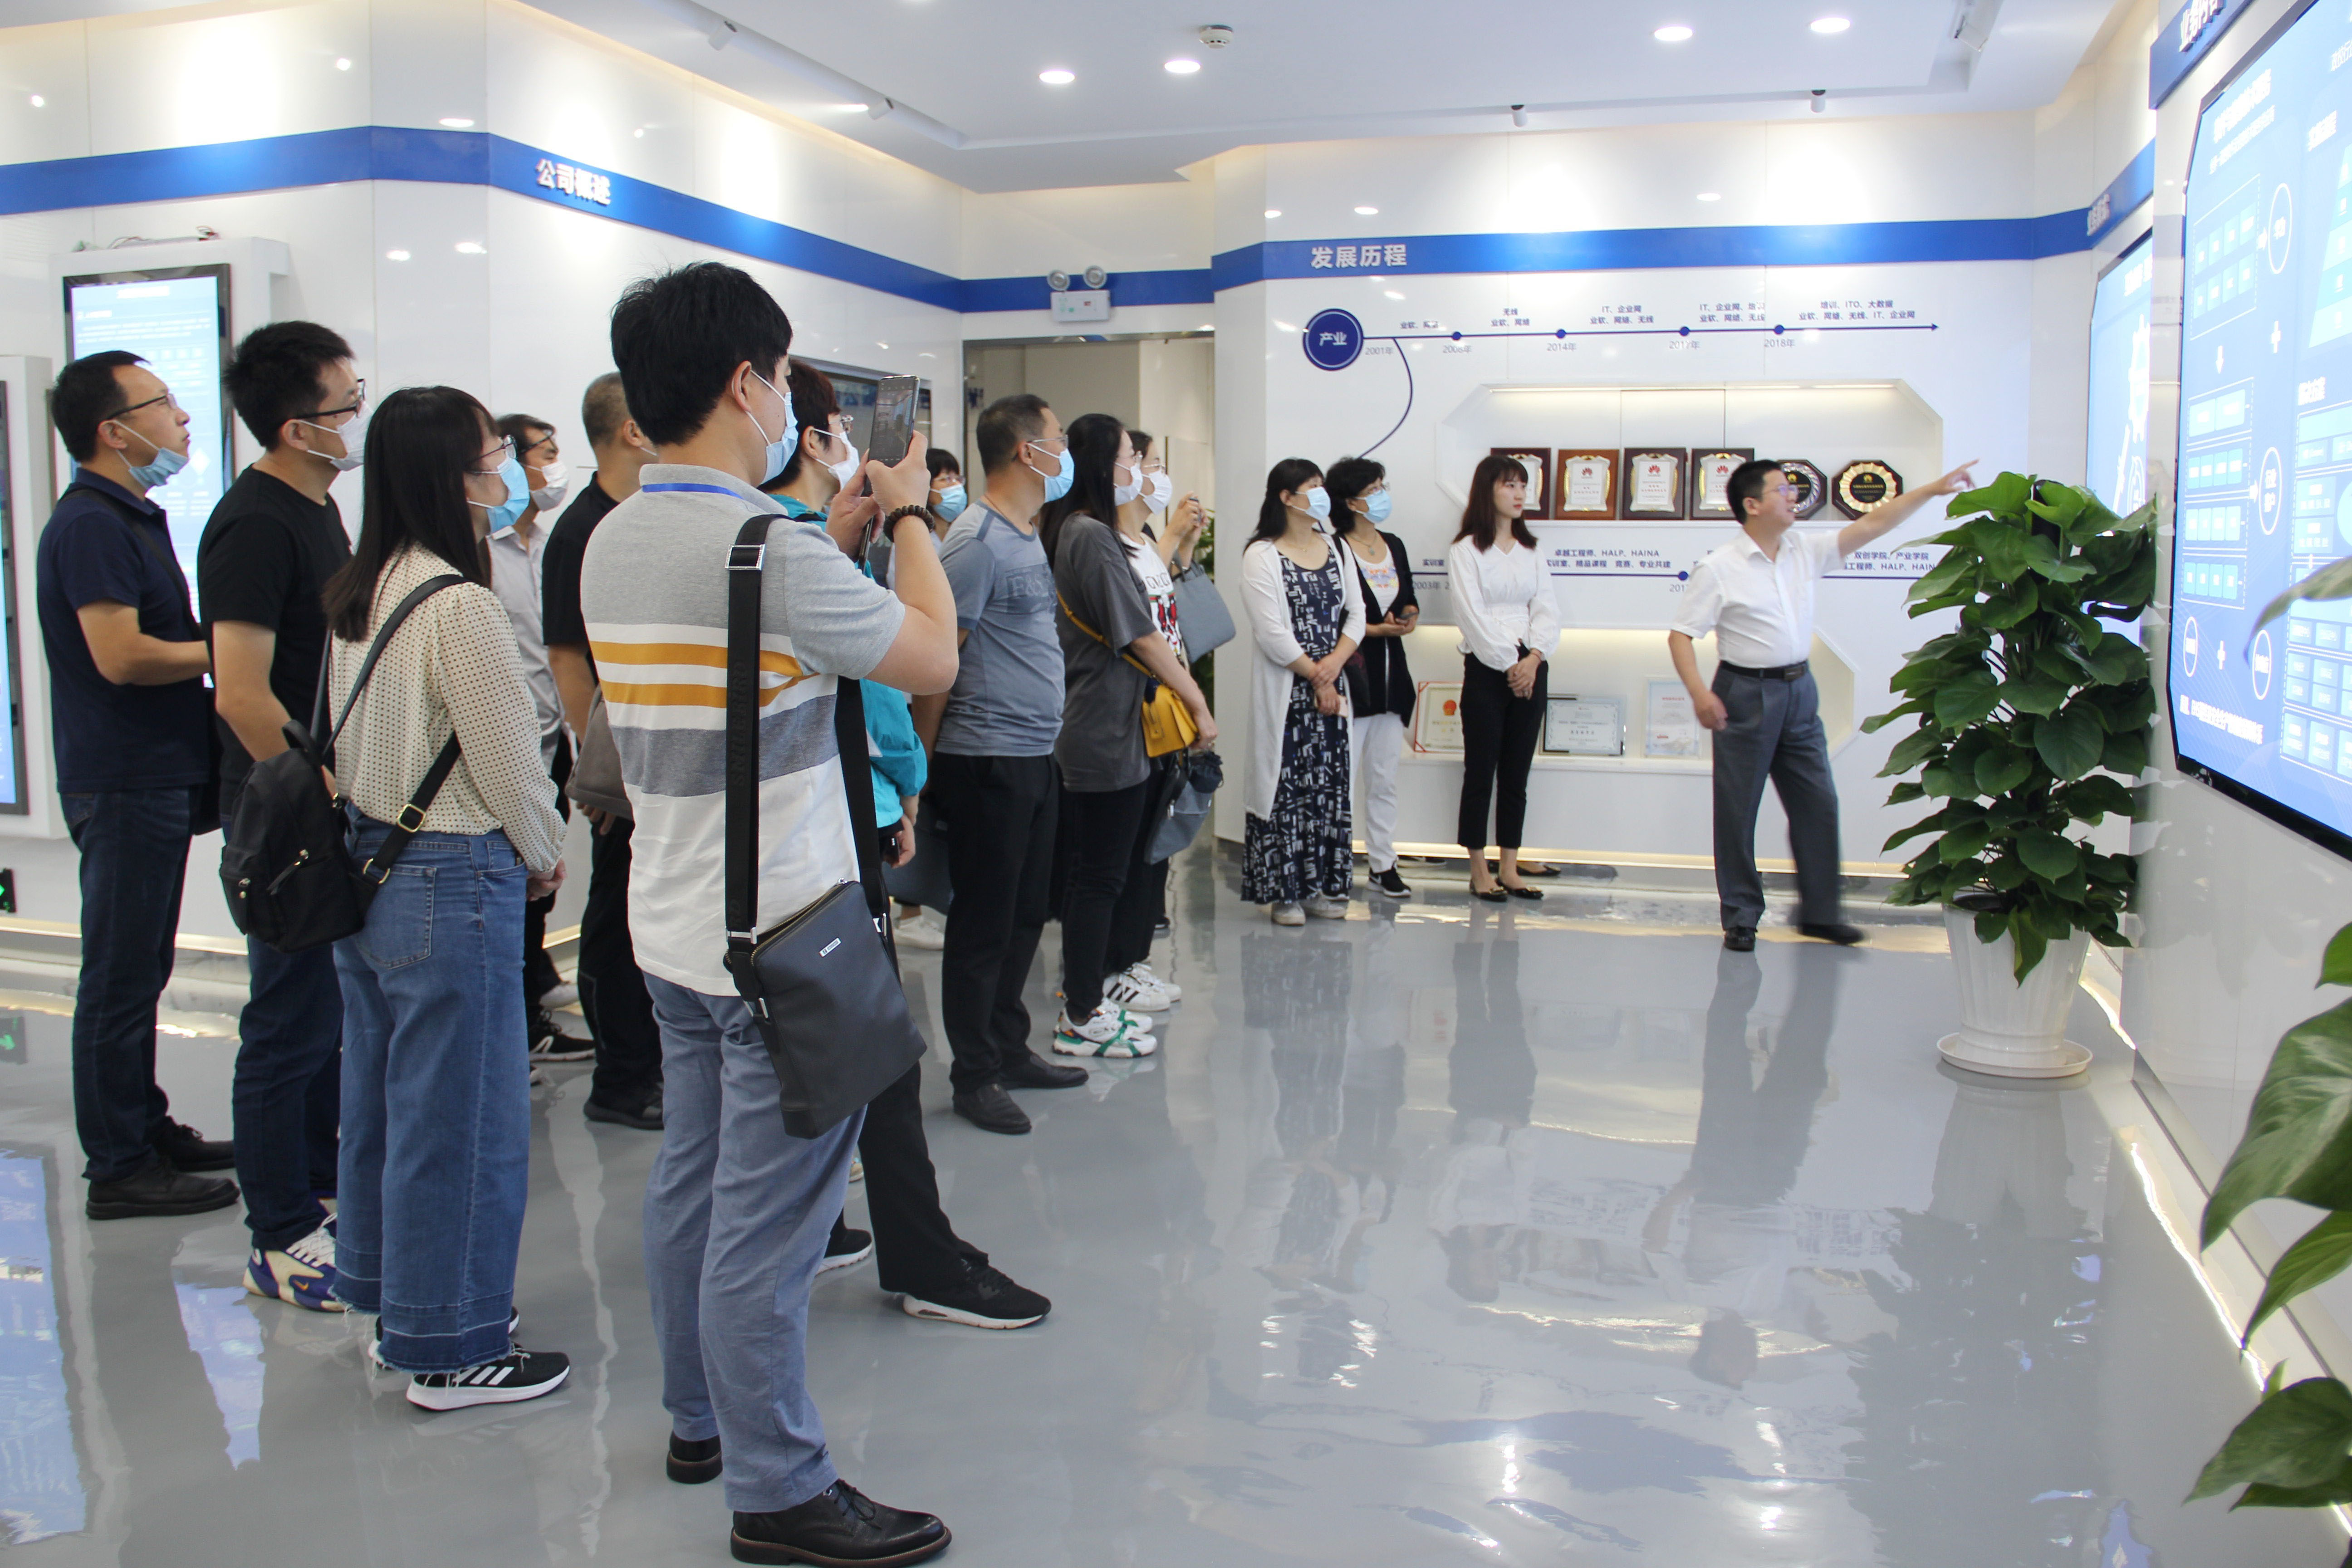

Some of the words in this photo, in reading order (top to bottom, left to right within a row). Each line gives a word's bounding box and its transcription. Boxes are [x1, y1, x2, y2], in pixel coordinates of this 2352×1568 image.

[1311, 244, 1407, 269] 发展历程
[1319, 332, 1347, 346] 产业
[1764, 338, 1794, 348] 2018年
[1365, 346, 1394, 355] 2001年
[1547, 343, 1577, 352] 2014年
